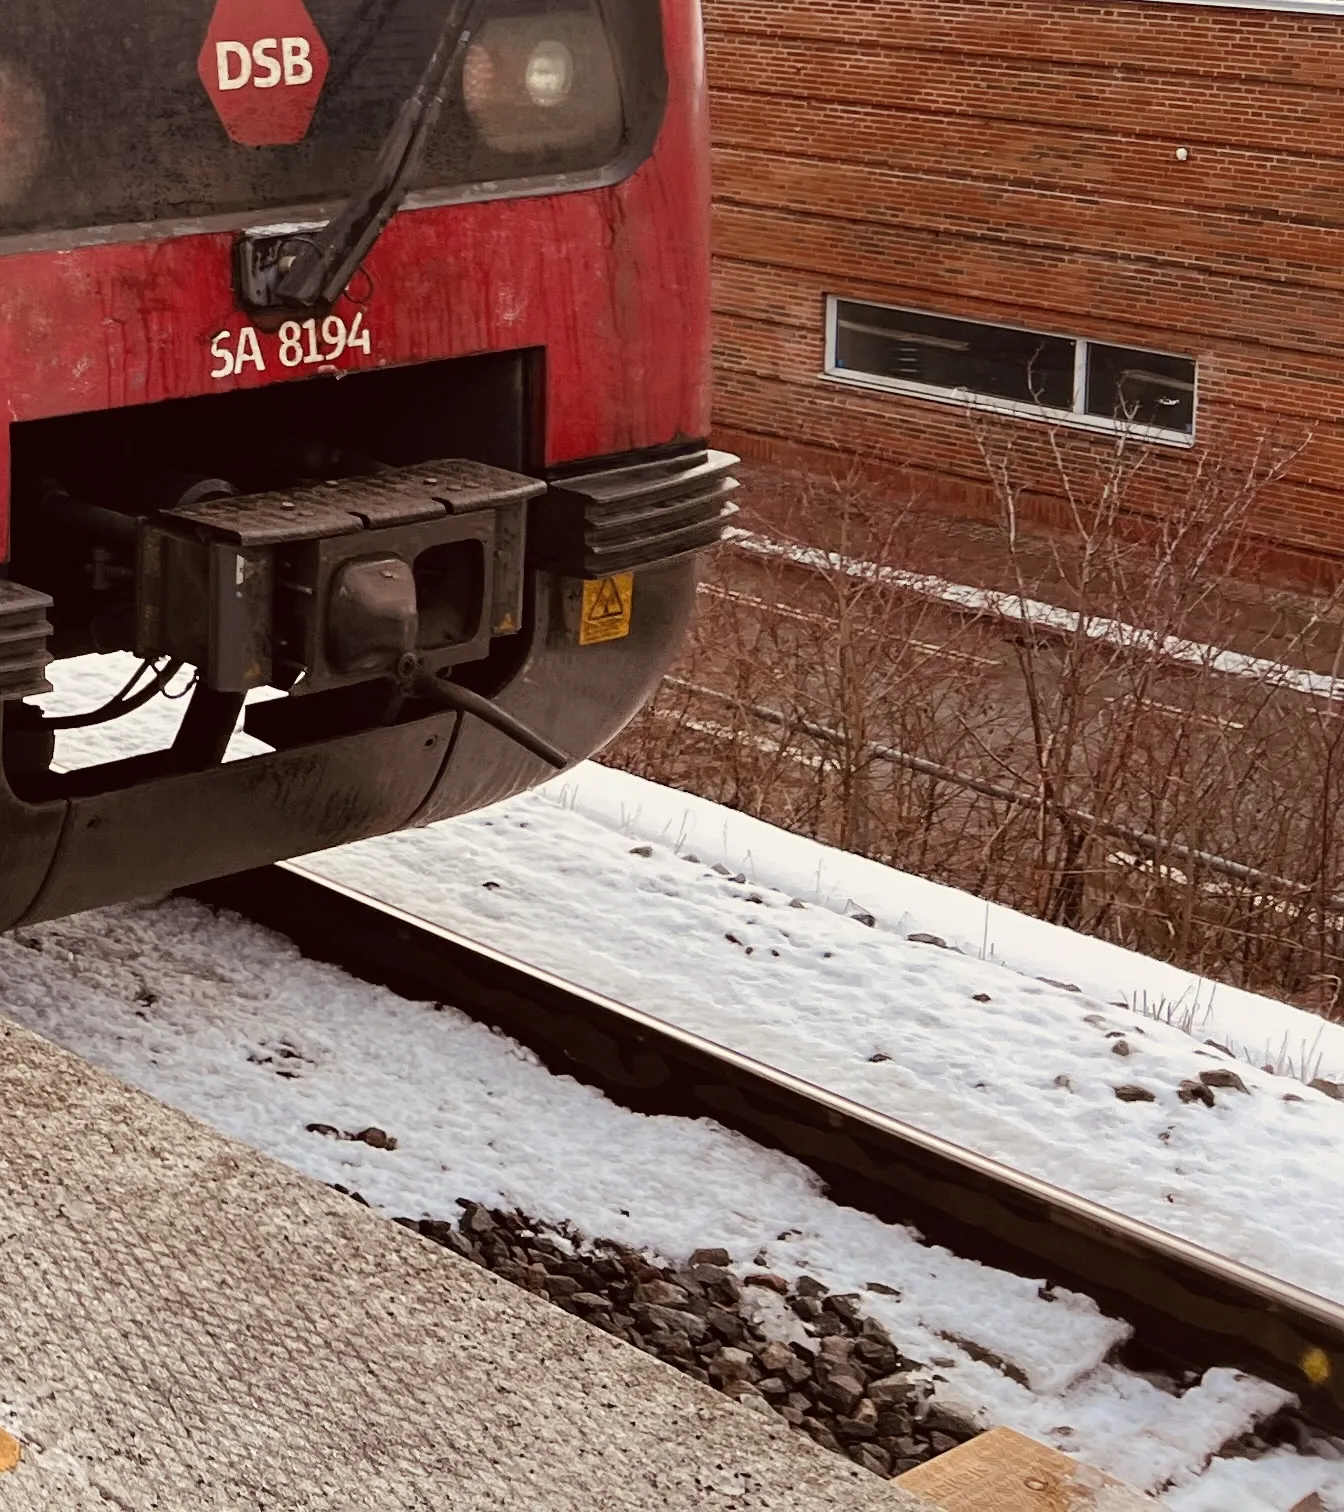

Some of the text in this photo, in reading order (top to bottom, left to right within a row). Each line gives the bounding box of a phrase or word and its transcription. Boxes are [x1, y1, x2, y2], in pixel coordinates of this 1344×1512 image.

[215, 36, 313, 91] DSB
[210, 311, 371, 378] SA 8194
